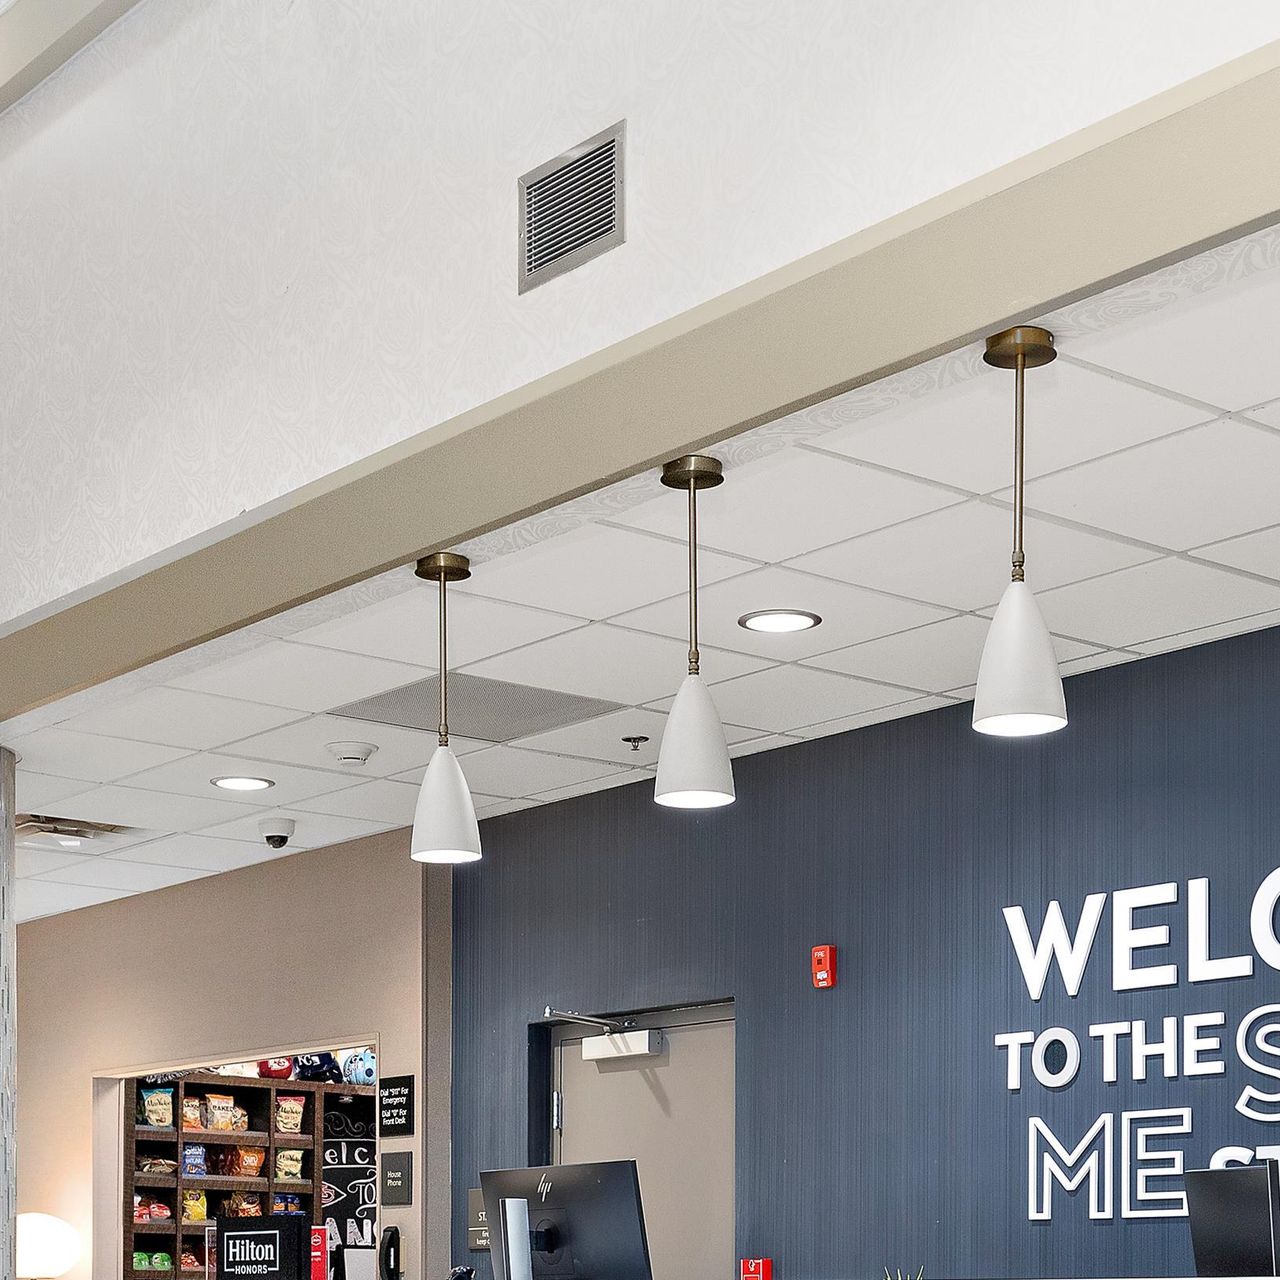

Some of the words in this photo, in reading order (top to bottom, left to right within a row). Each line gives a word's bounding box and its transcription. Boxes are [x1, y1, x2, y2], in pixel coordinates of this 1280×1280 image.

[994, 1026, 1080, 1090] TO
[1088, 1011, 1225, 1082] THE
[401, 1086, 409, 1095] For
[383, 1096, 407, 1106] Emergency
[399, 1108, 408, 1116] For
[383, 1117, 395, 1126] Front
[395, 1116, 407, 1125] Desk
[324, 1142, 377, 1165] elc
[1028, 1107, 1192, 1220] ME
[387, 1170, 402, 1179] House
[387, 1178, 402, 1187] Phone
[478, 1211, 488, 1222] ST
[228, 1239, 275, 1262] Hilton
[234, 1264, 268, 1275] HONORS
